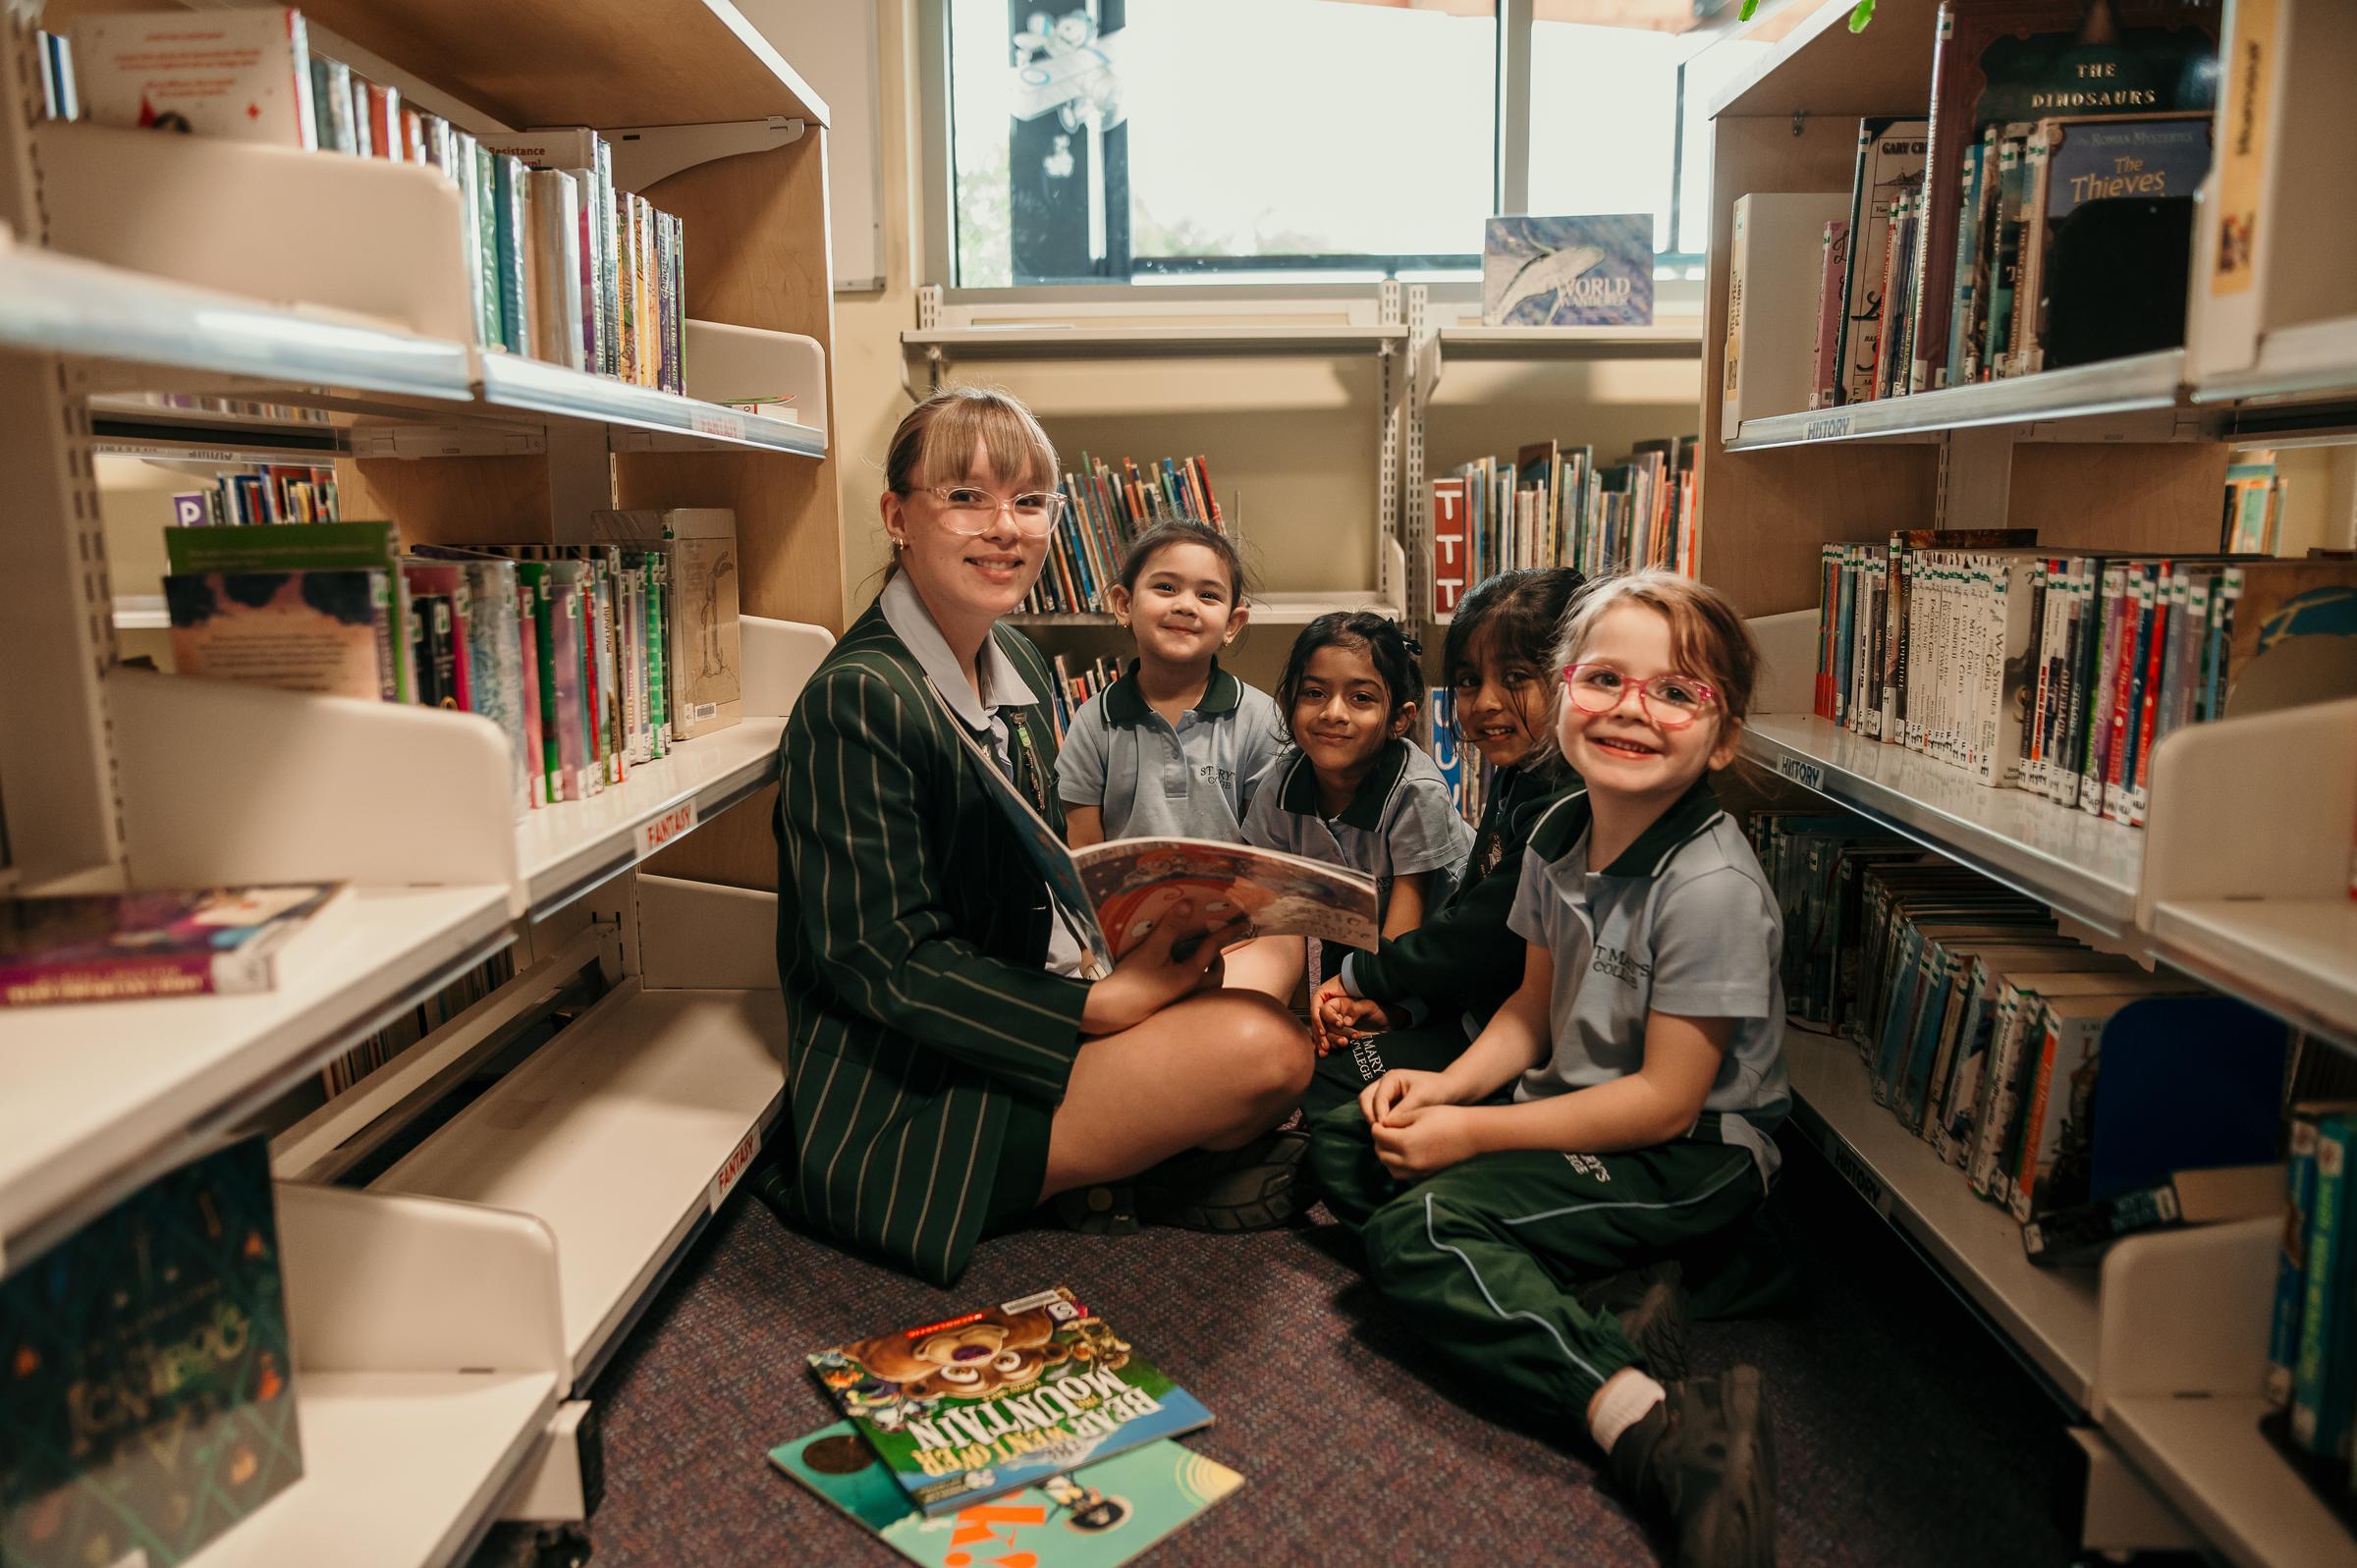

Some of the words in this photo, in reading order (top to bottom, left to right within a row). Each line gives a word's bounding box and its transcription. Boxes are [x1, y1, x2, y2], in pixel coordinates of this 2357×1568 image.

[2076, 63, 2117, 79] THE
[2031, 89, 2157, 109] DINOSAURS
[488, 146, 546, 156] Resistance
[1882, 142, 1908, 154] GARY
[2114, 156, 2144, 173] The
[2070, 170, 2166, 204] Thieves
[1920, 198, 1932, 267] WATERHOUSE
[1557, 277, 1631, 297] WORLD
[1917, 272, 1927, 319] HAWKINS
[1807, 417, 1850, 441] HISTORY
[179, 501, 201, 527] P
[1435, 490, 1462, 520] T
[1436, 535, 1463, 565] T
[1436, 579, 1464, 608] T
[1951, 617, 1960, 659] POMPEII
[1995, 633, 2004, 665] WAR
[1897, 630, 1906, 692] SAPPHIRE
[1984, 654, 1995, 690] GIRLS
[1990, 670, 2001, 715] STORIES
[1200, 766, 1214, 776] ST
[1435, 741, 1459, 771] U
[1782, 757, 1820, 786] HISTORY
[647, 804, 691, 849] FANTASY
[1593, 961, 1638, 990] COLL
[1349, 1039, 1374, 1081] OLLEGE
[1362, 1039, 1386, 1074] MARY
[718, 1134, 754, 1195] FANTASY
[906, 1363, 1132, 1452] MOUNTAIN
[1069, 1386, 1164, 1439] BEAR
[911, 1442, 992, 1477] OVER
[994, 1426, 1074, 1465] WENT
